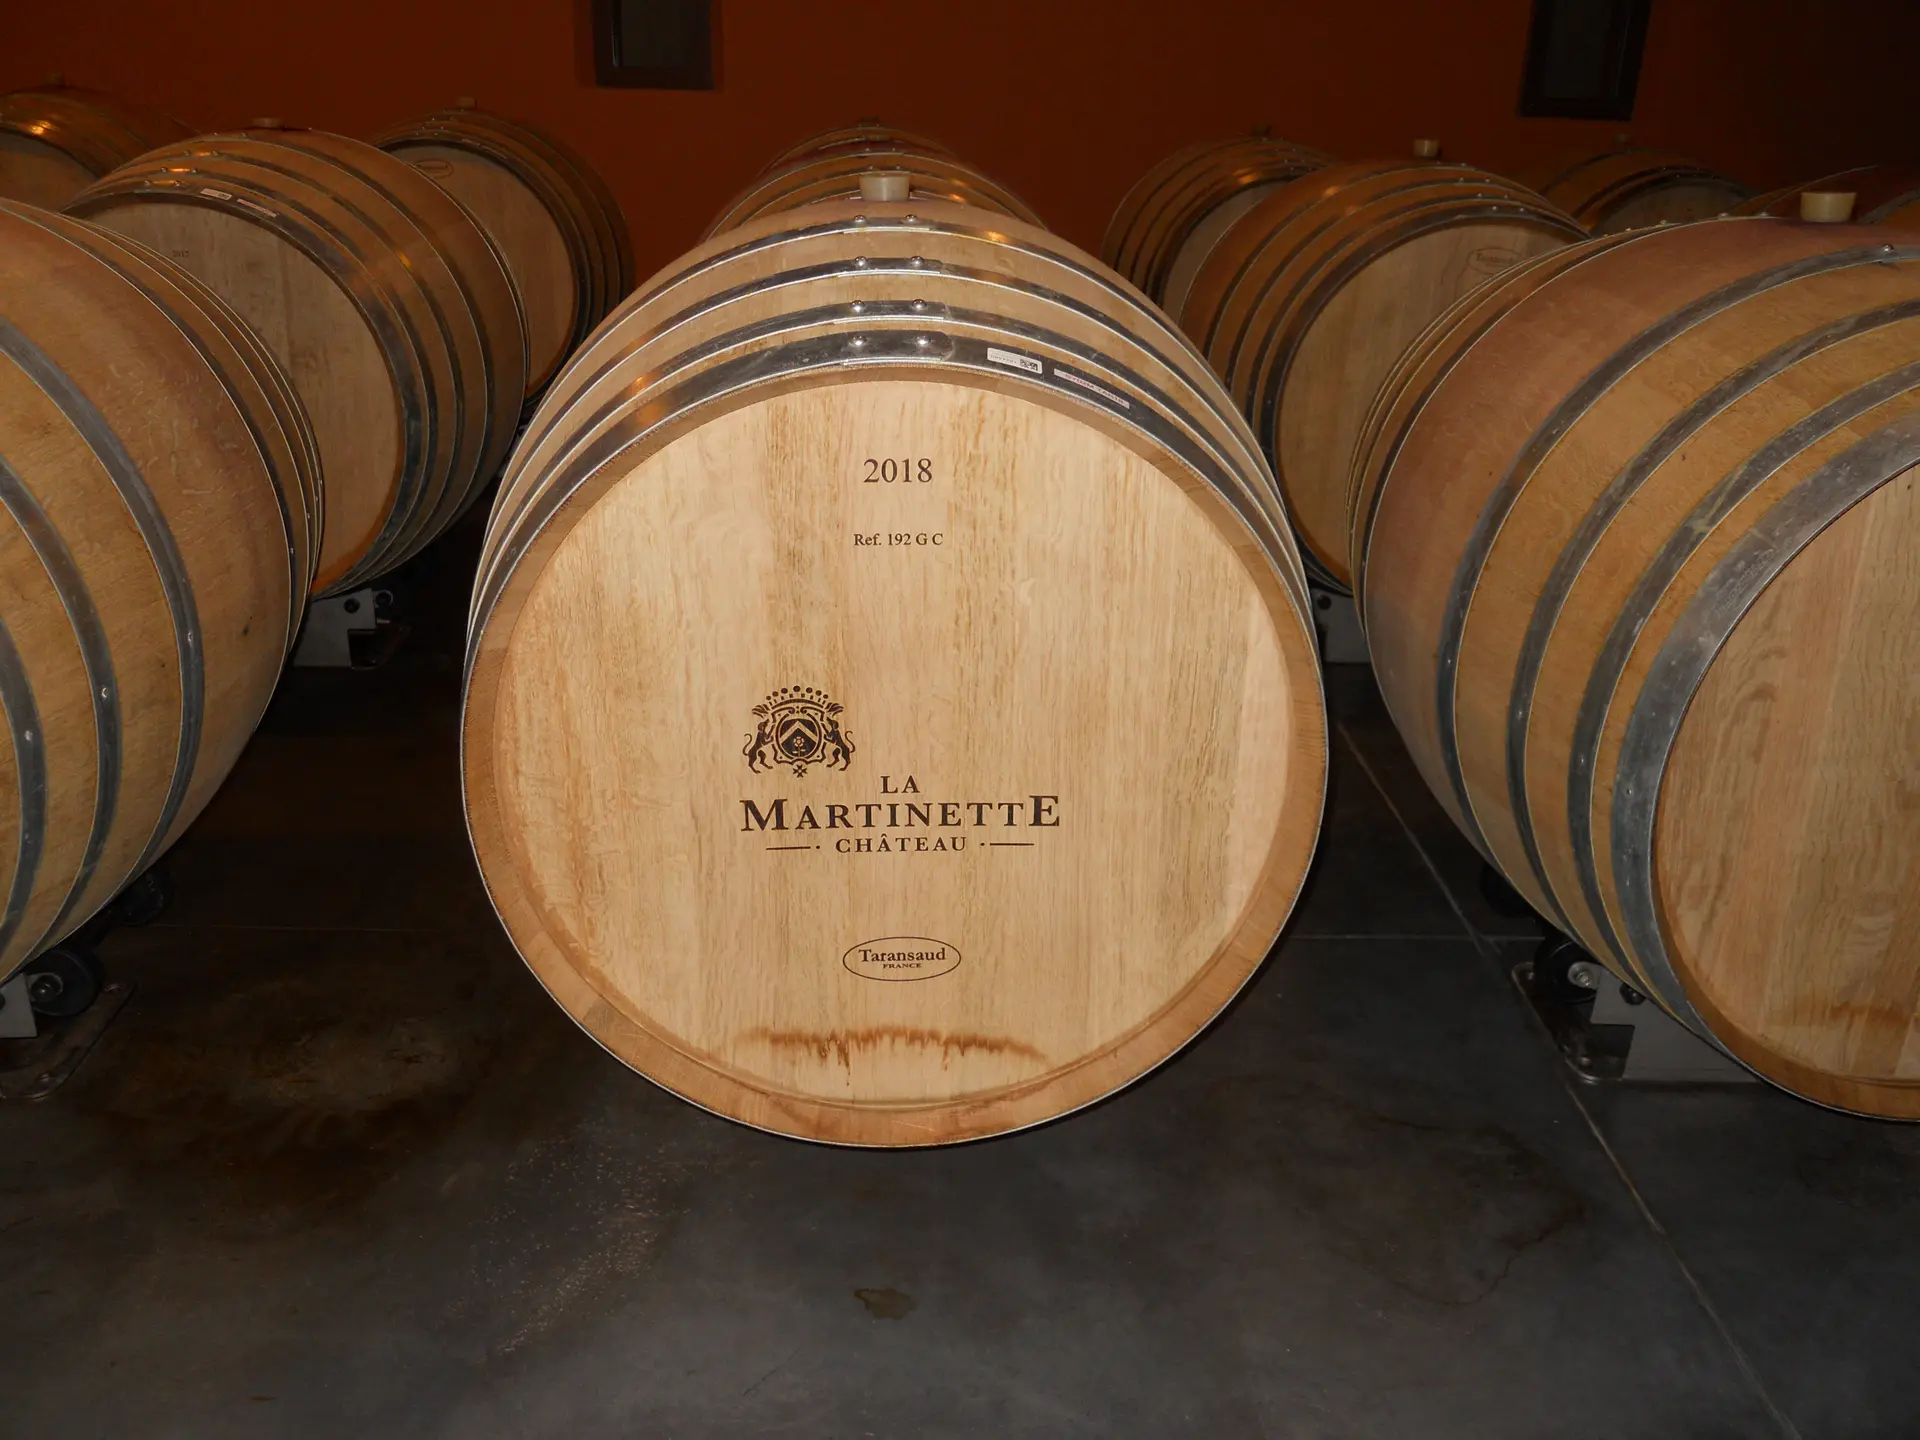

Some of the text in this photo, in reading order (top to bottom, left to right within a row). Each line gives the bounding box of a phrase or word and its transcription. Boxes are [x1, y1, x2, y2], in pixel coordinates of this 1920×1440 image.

[864, 459, 932, 483] 2018
[854, 533, 944, 546] Ref. 192 G C
[880, 775, 920, 794] LA
[740, 795, 1060, 832] MARTINETTE
[835, 834, 967, 854] CHÂTEAU
[858, 947, 946, 963] Taransaud
